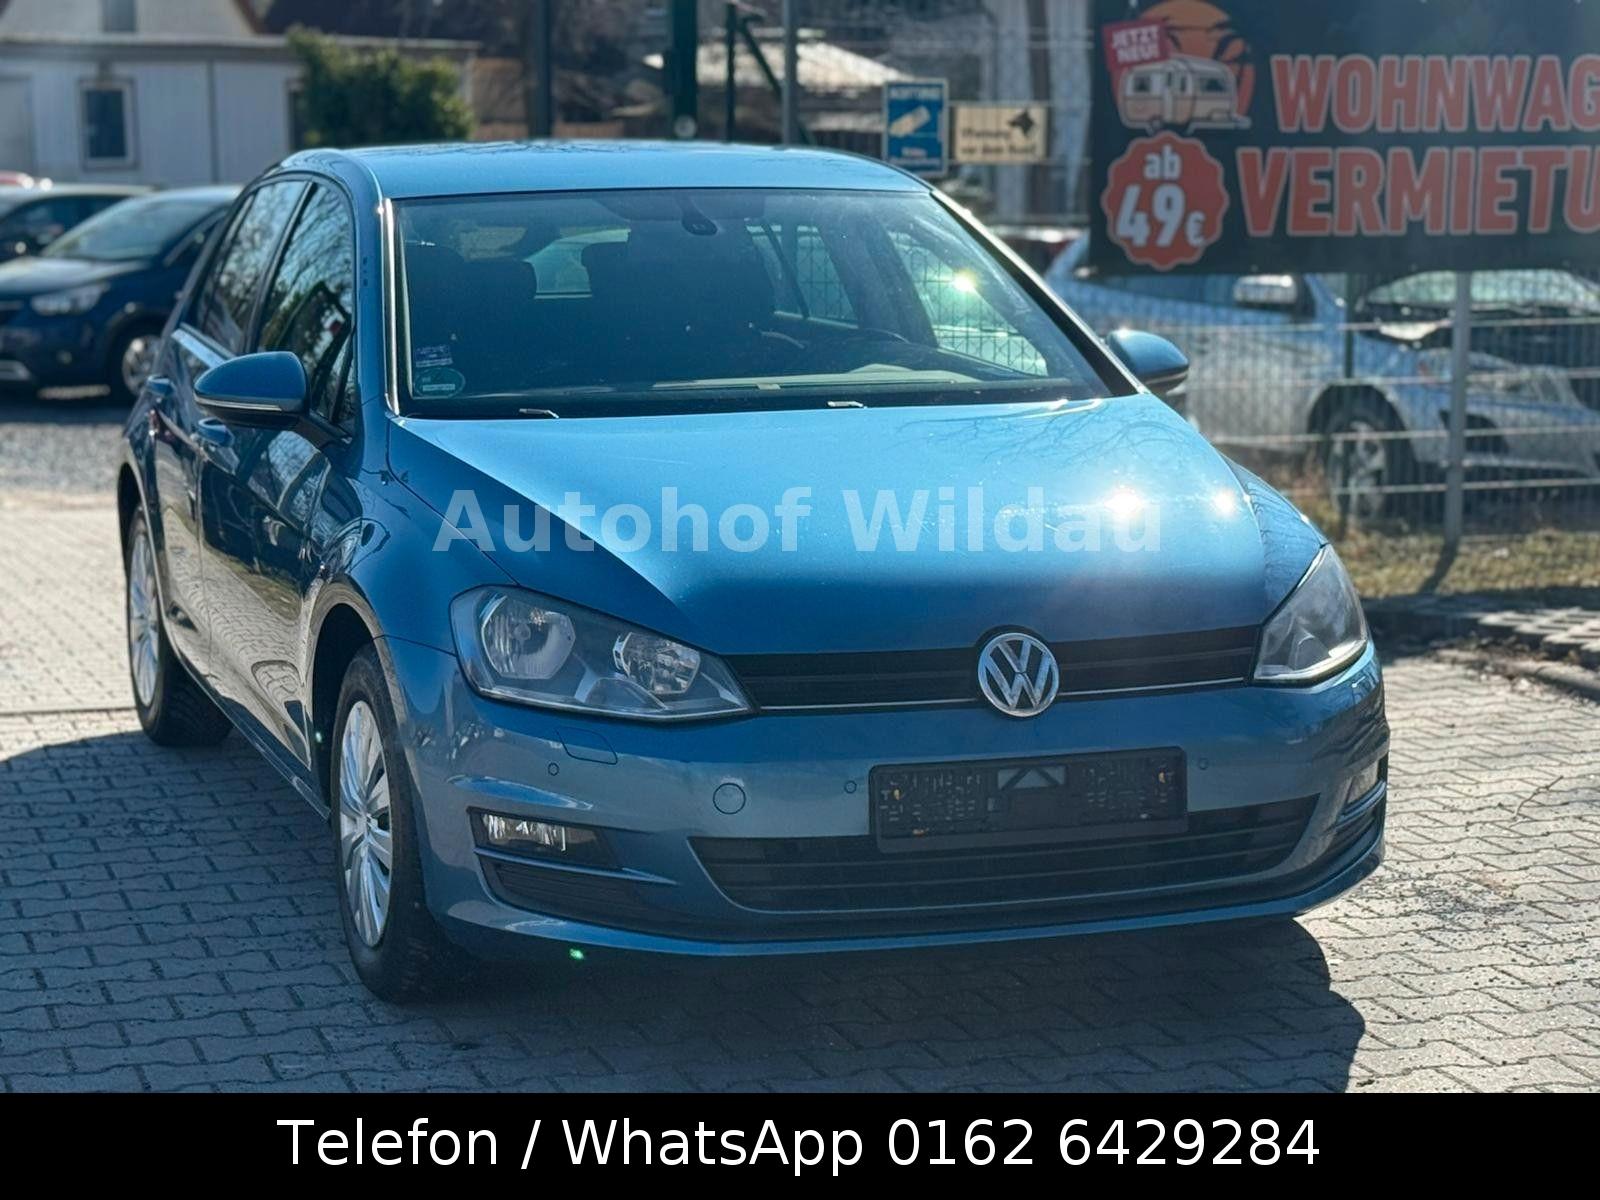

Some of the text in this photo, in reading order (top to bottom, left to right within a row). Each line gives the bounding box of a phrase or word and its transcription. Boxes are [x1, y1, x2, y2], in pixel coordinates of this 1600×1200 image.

[1112, 25, 1160, 48] JETZT
[1270, 54, 1600, 133] WOHNWAG
[1144, 144, 1182, 180] ab
[1235, 146, 1600, 237] VERMIETU
[1116, 183, 1206, 248] 49€
[979, 634, 1058, 716] VW
